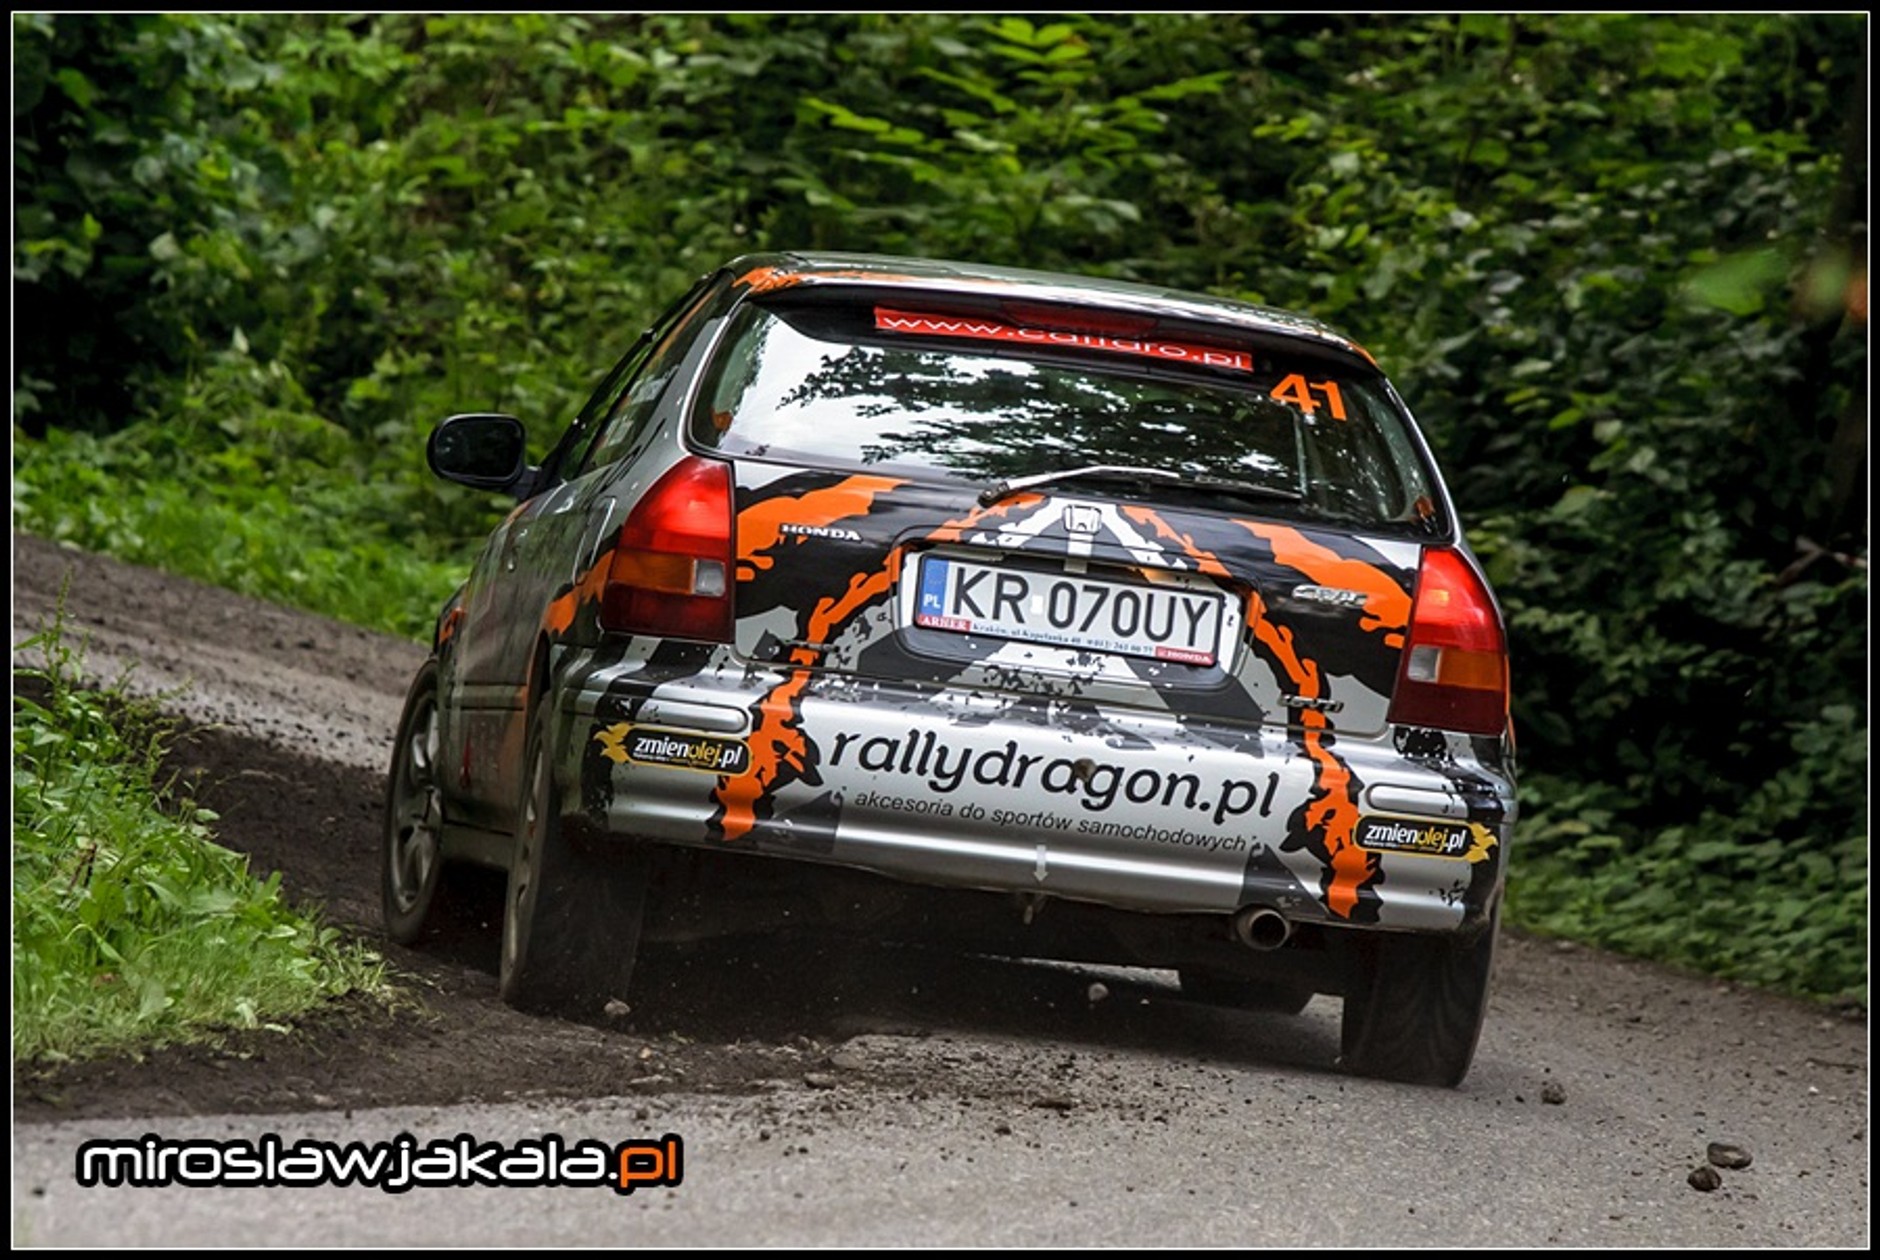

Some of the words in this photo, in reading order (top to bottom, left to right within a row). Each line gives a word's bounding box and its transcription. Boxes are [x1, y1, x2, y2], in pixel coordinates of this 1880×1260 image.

[1269, 374, 1346, 421] 41
[781, 524, 862, 541] HONDA
[923, 594, 941, 608] PL
[953, 567, 1029, 624] KR
[1047, 580, 1211, 646] 070UY
[1167, 651, 1210, 662] HONDA
[634, 736, 743, 768] zmienolej.pl
[830, 729, 1279, 825] rallydragon.pl
[855, 790, 953, 817] akcesoria
[961, 799, 985, 820] do
[990, 807, 1071, 831] sportów
[1077, 819, 1246, 853] samochodowych
[1365, 823, 1467, 852] zmienolej.pl
